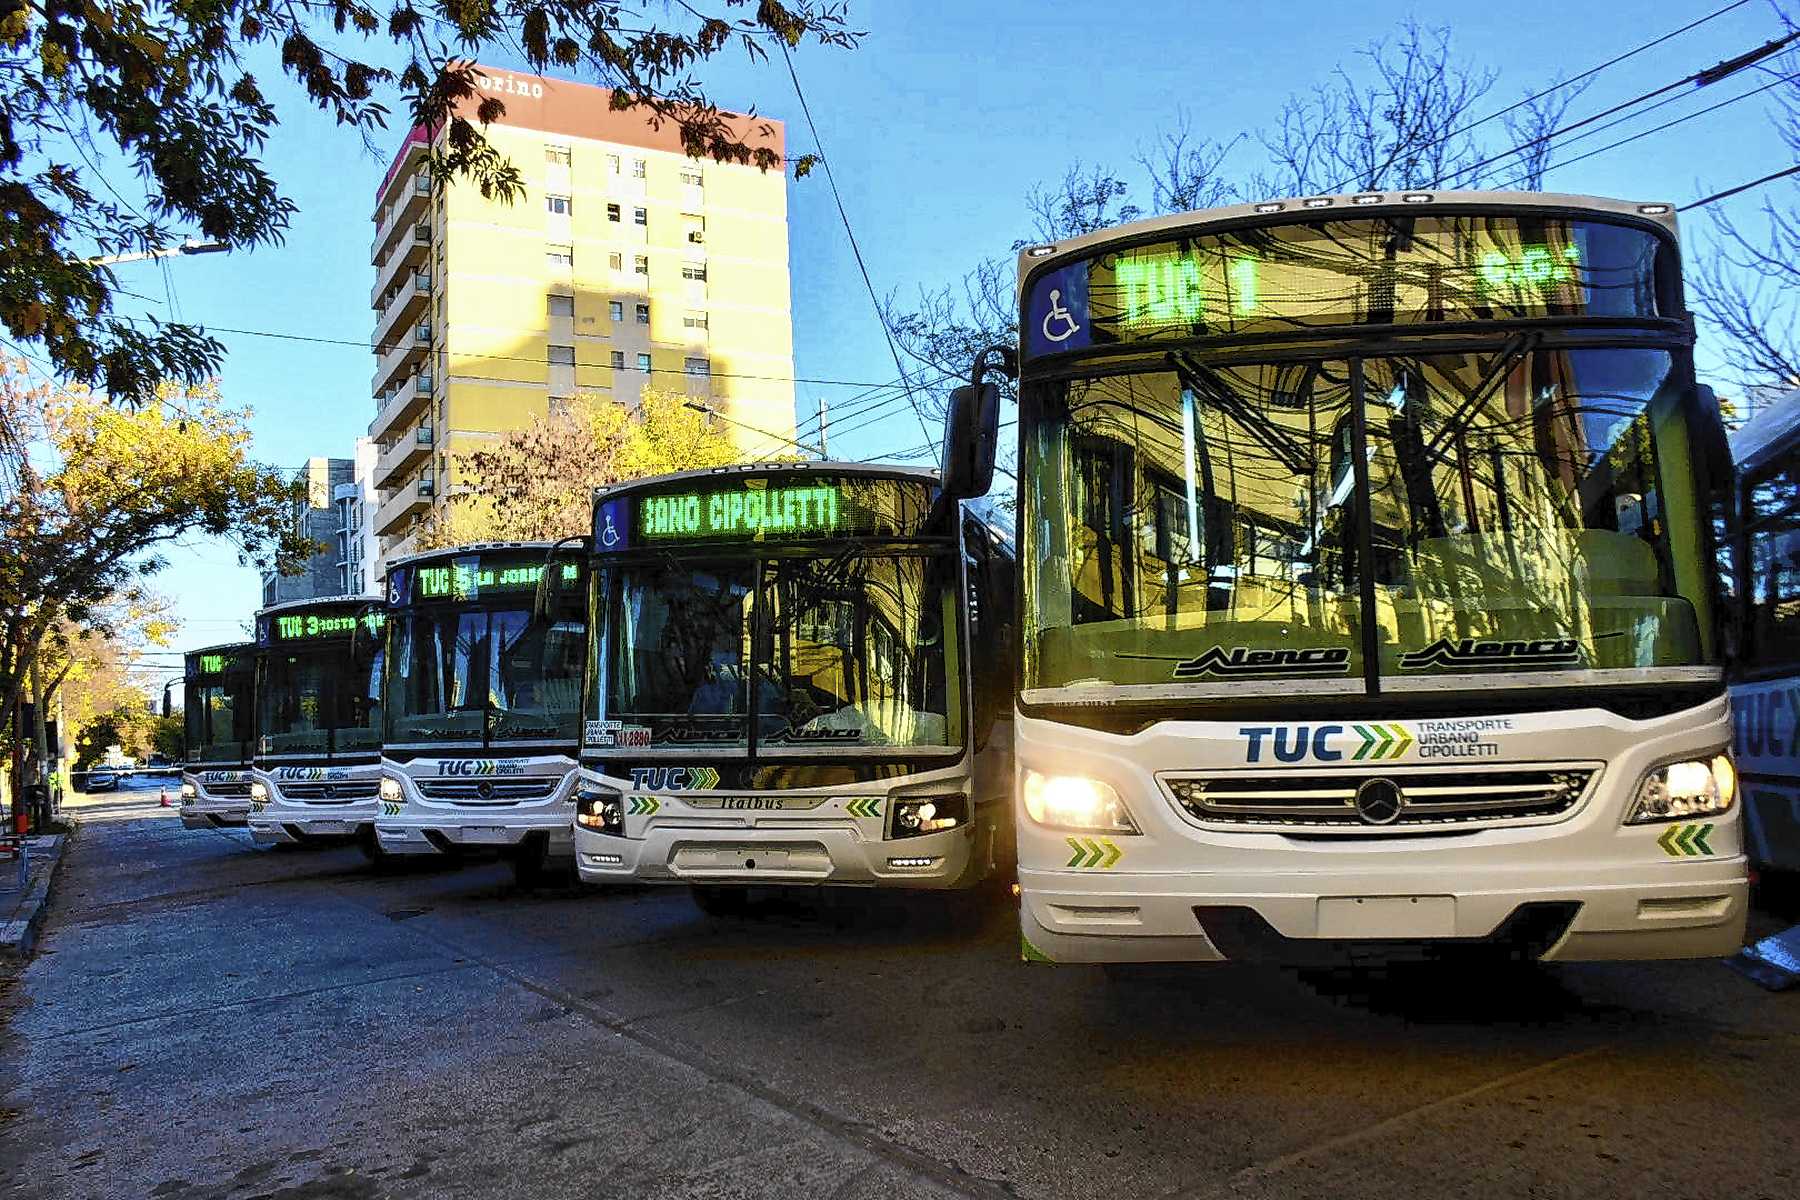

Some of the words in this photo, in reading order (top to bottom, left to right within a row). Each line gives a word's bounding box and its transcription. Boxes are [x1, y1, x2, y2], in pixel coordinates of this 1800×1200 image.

[464, 72, 543, 99] orino
[710, 488, 836, 531] CIPOLLETTI
[419, 568, 448, 596] TUC
[278, 617, 303, 639] TUC
[307, 616, 319, 635] 3
[1173, 646, 1351, 678] Alenco
[1399, 638, 1580, 668] Alenco
[203, 655, 222, 672] TUC
[1417, 719, 1513, 733] TRANSPORTE
[1240, 725, 1343, 763] TUC
[1418, 732, 1479, 745] URBANO
[1419, 743, 1498, 758] CIPOLLETTI
[205, 771, 225, 782] TUC
[279, 767, 307, 780] TUC
[438, 760, 473, 776] TUC
[630, 768, 685, 791] TUC
[720, 797, 784, 811] Italbus
